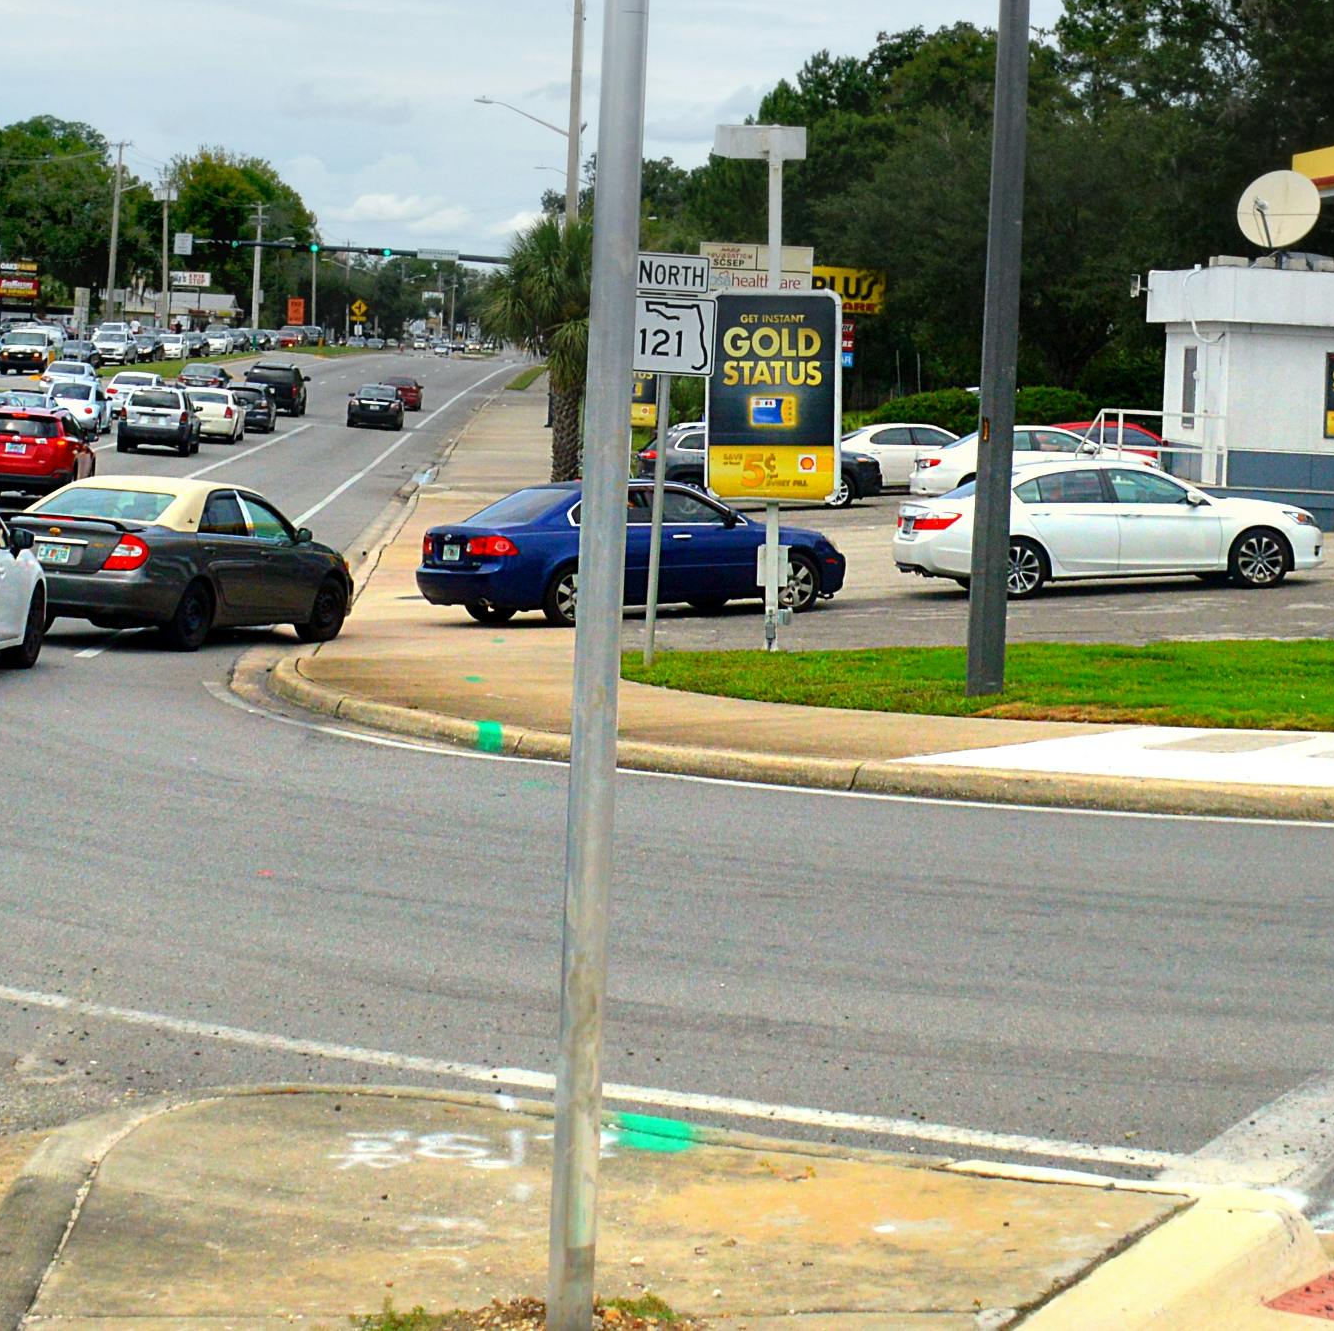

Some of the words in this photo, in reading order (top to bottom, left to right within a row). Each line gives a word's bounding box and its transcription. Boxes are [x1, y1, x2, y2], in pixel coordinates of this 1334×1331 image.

[639, 260, 705, 288] NORTH
[713, 258, 745, 267] SCSEP
[740, 314, 759, 324] GET
[762, 314, 806, 324] INSTANT
[640, 327, 683, 358] 121
[723, 326, 822, 358] GOLD
[723, 360, 823, 386] STATUS
